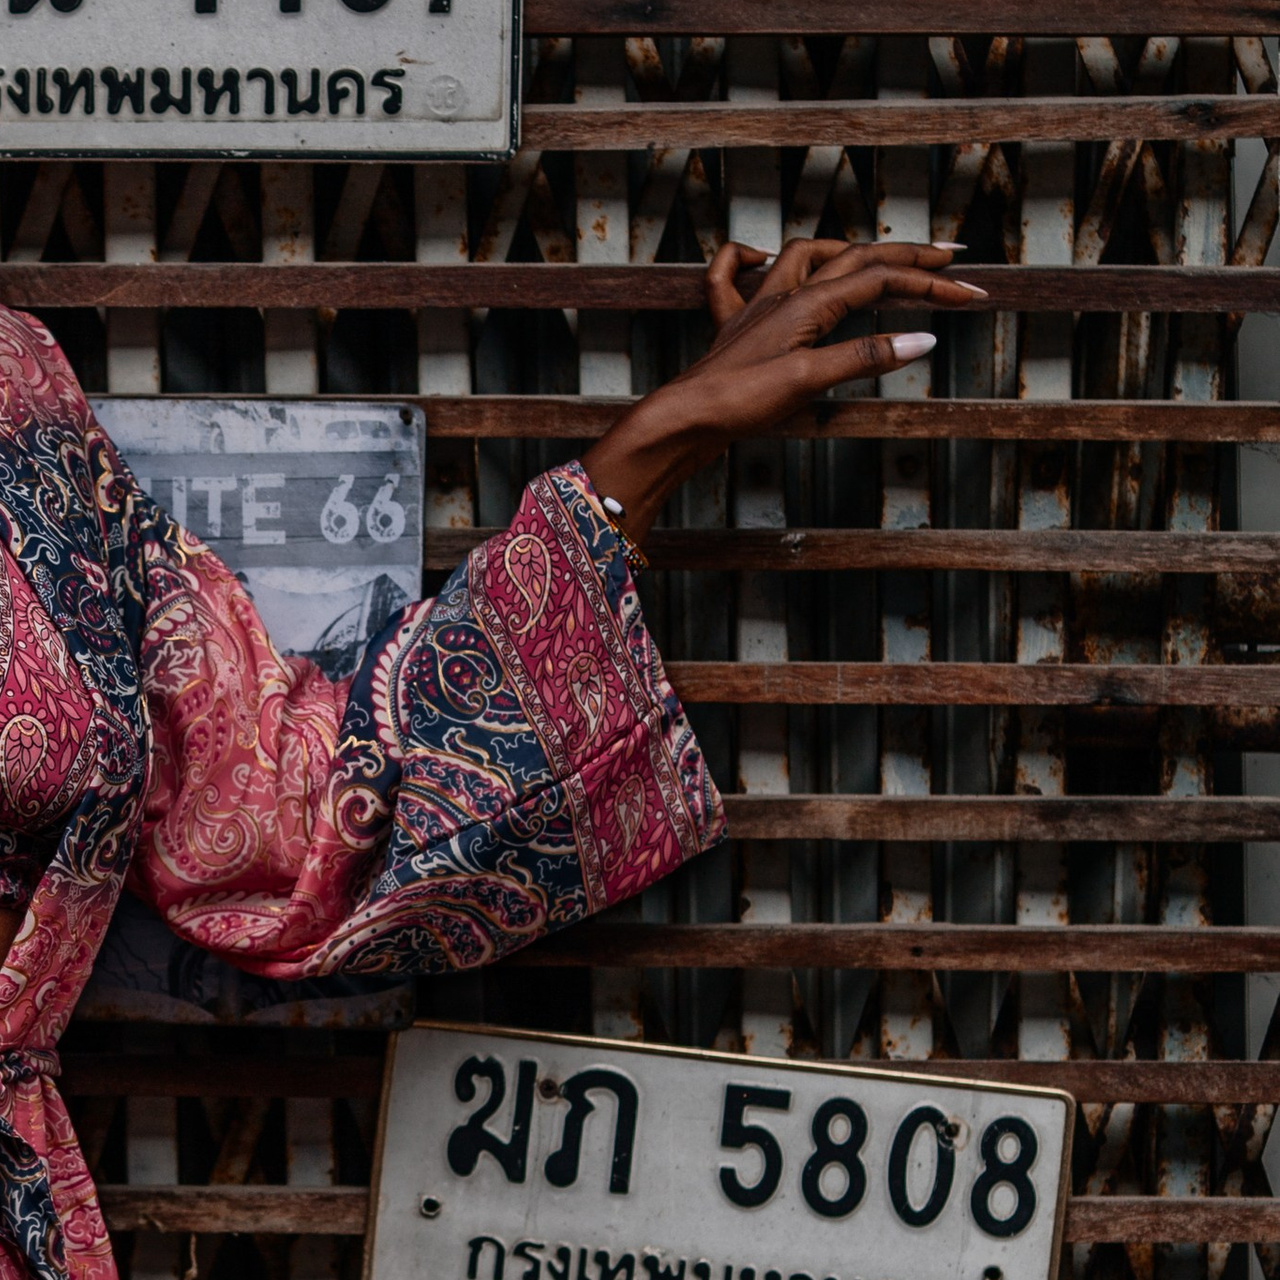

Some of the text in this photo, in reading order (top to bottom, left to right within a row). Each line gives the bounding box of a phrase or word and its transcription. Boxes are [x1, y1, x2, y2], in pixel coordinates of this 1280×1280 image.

[320, 473, 407, 545] 66
[446, 1053, 1040, 1238] ฆภ 5808
